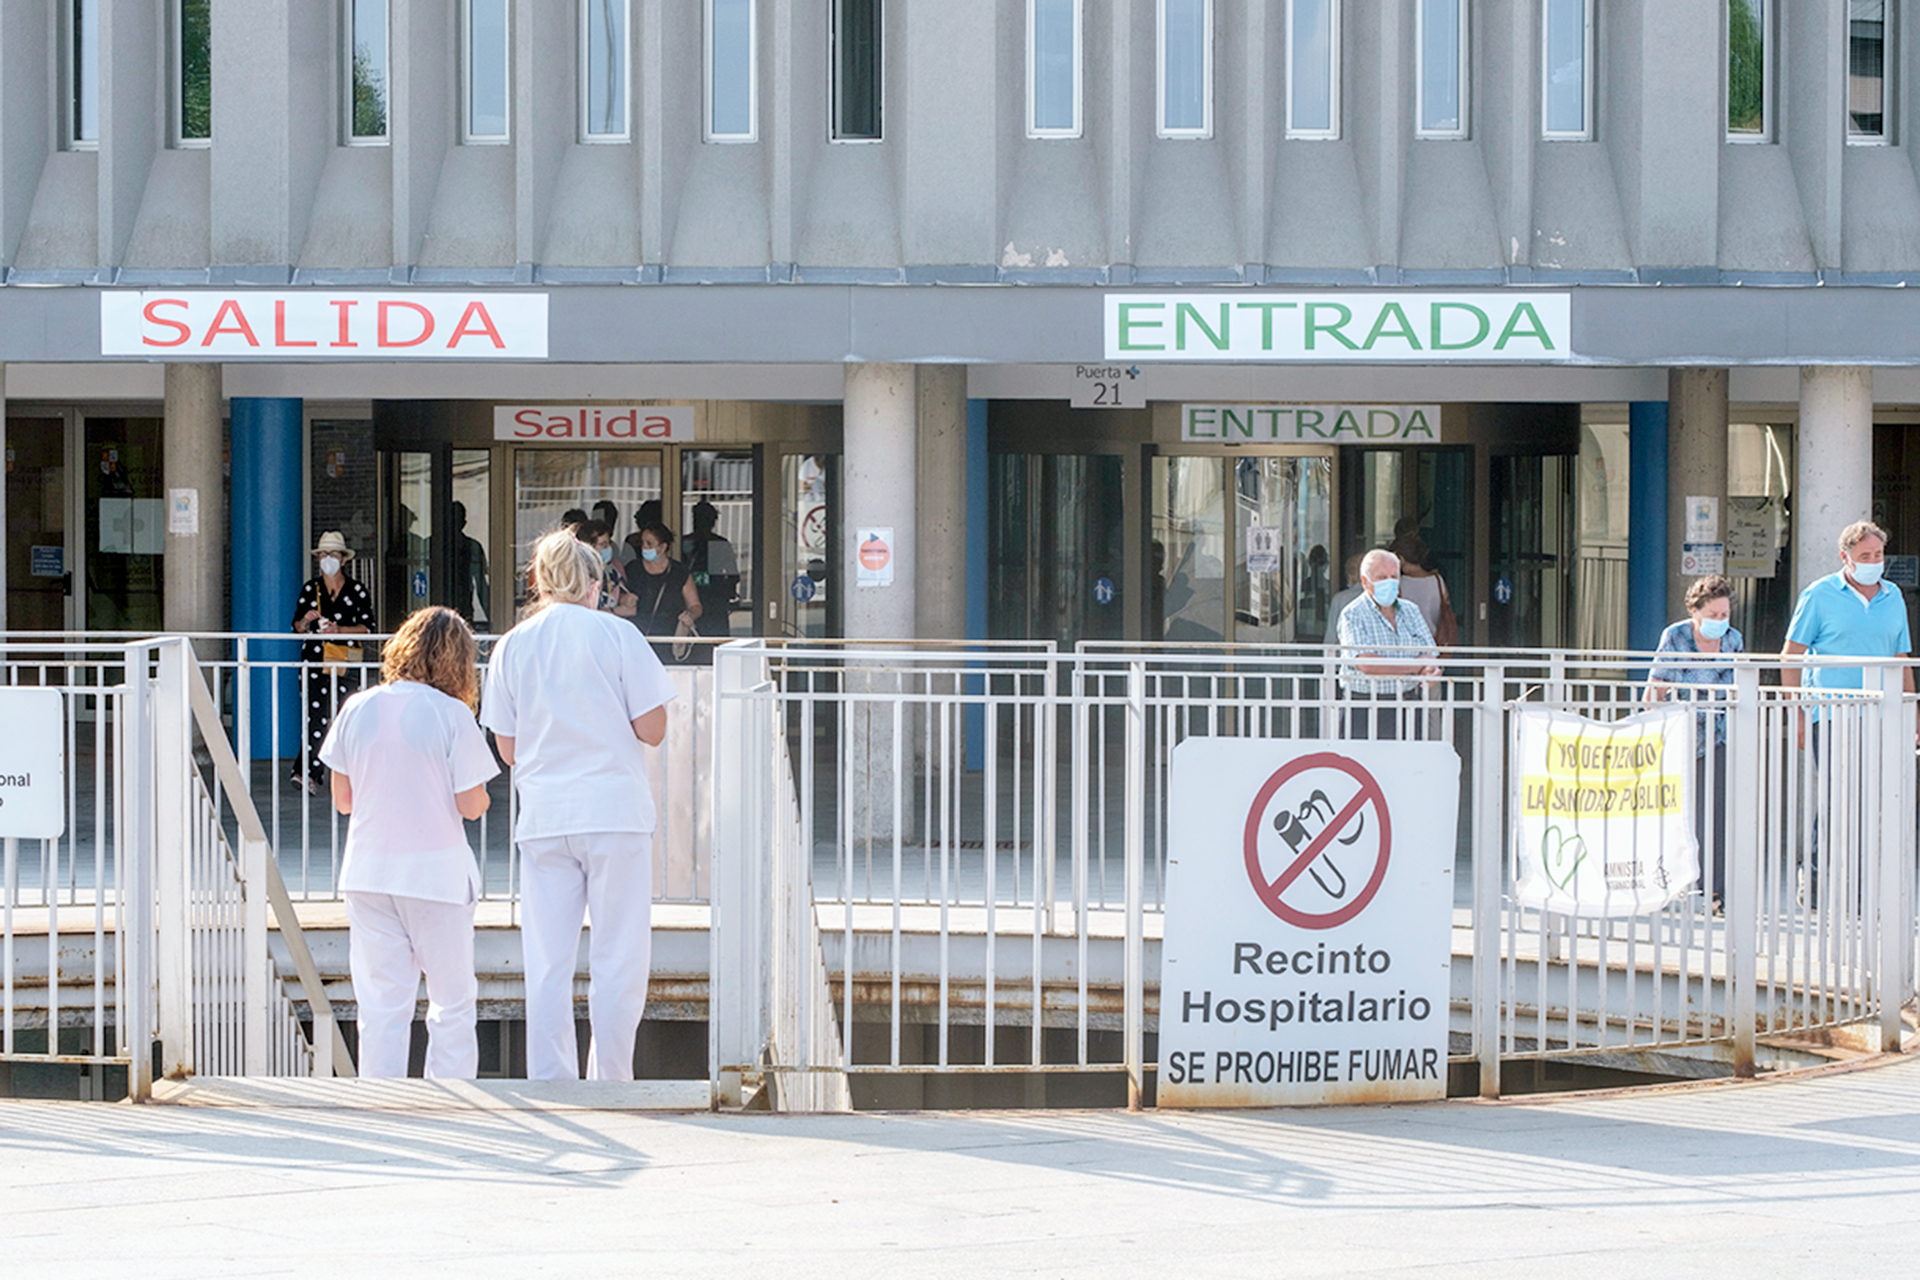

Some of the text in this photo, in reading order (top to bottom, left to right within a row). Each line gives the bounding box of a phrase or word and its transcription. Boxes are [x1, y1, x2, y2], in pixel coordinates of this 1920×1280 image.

[142, 298, 506, 349] SALIDA
[1117, 301, 1556, 352] ENTRADA
[1076, 365, 1121, 379] Puerta
[1093, 382, 1122, 406] 21
[514, 409, 672, 438] Salida
[1189, 408, 1433, 438] ENTRADA
[1560, 742, 1657, 770] YO DEFIENDO
[1527, 785, 1546, 810] LA
[1552, 787, 1617, 813] SANIDAD
[1233, 942, 1391, 975] Recinto
[1182, 989, 1431, 1032] Hospitalario
[1168, 1048, 1438, 1085] SE PROHIBE FUMAR
